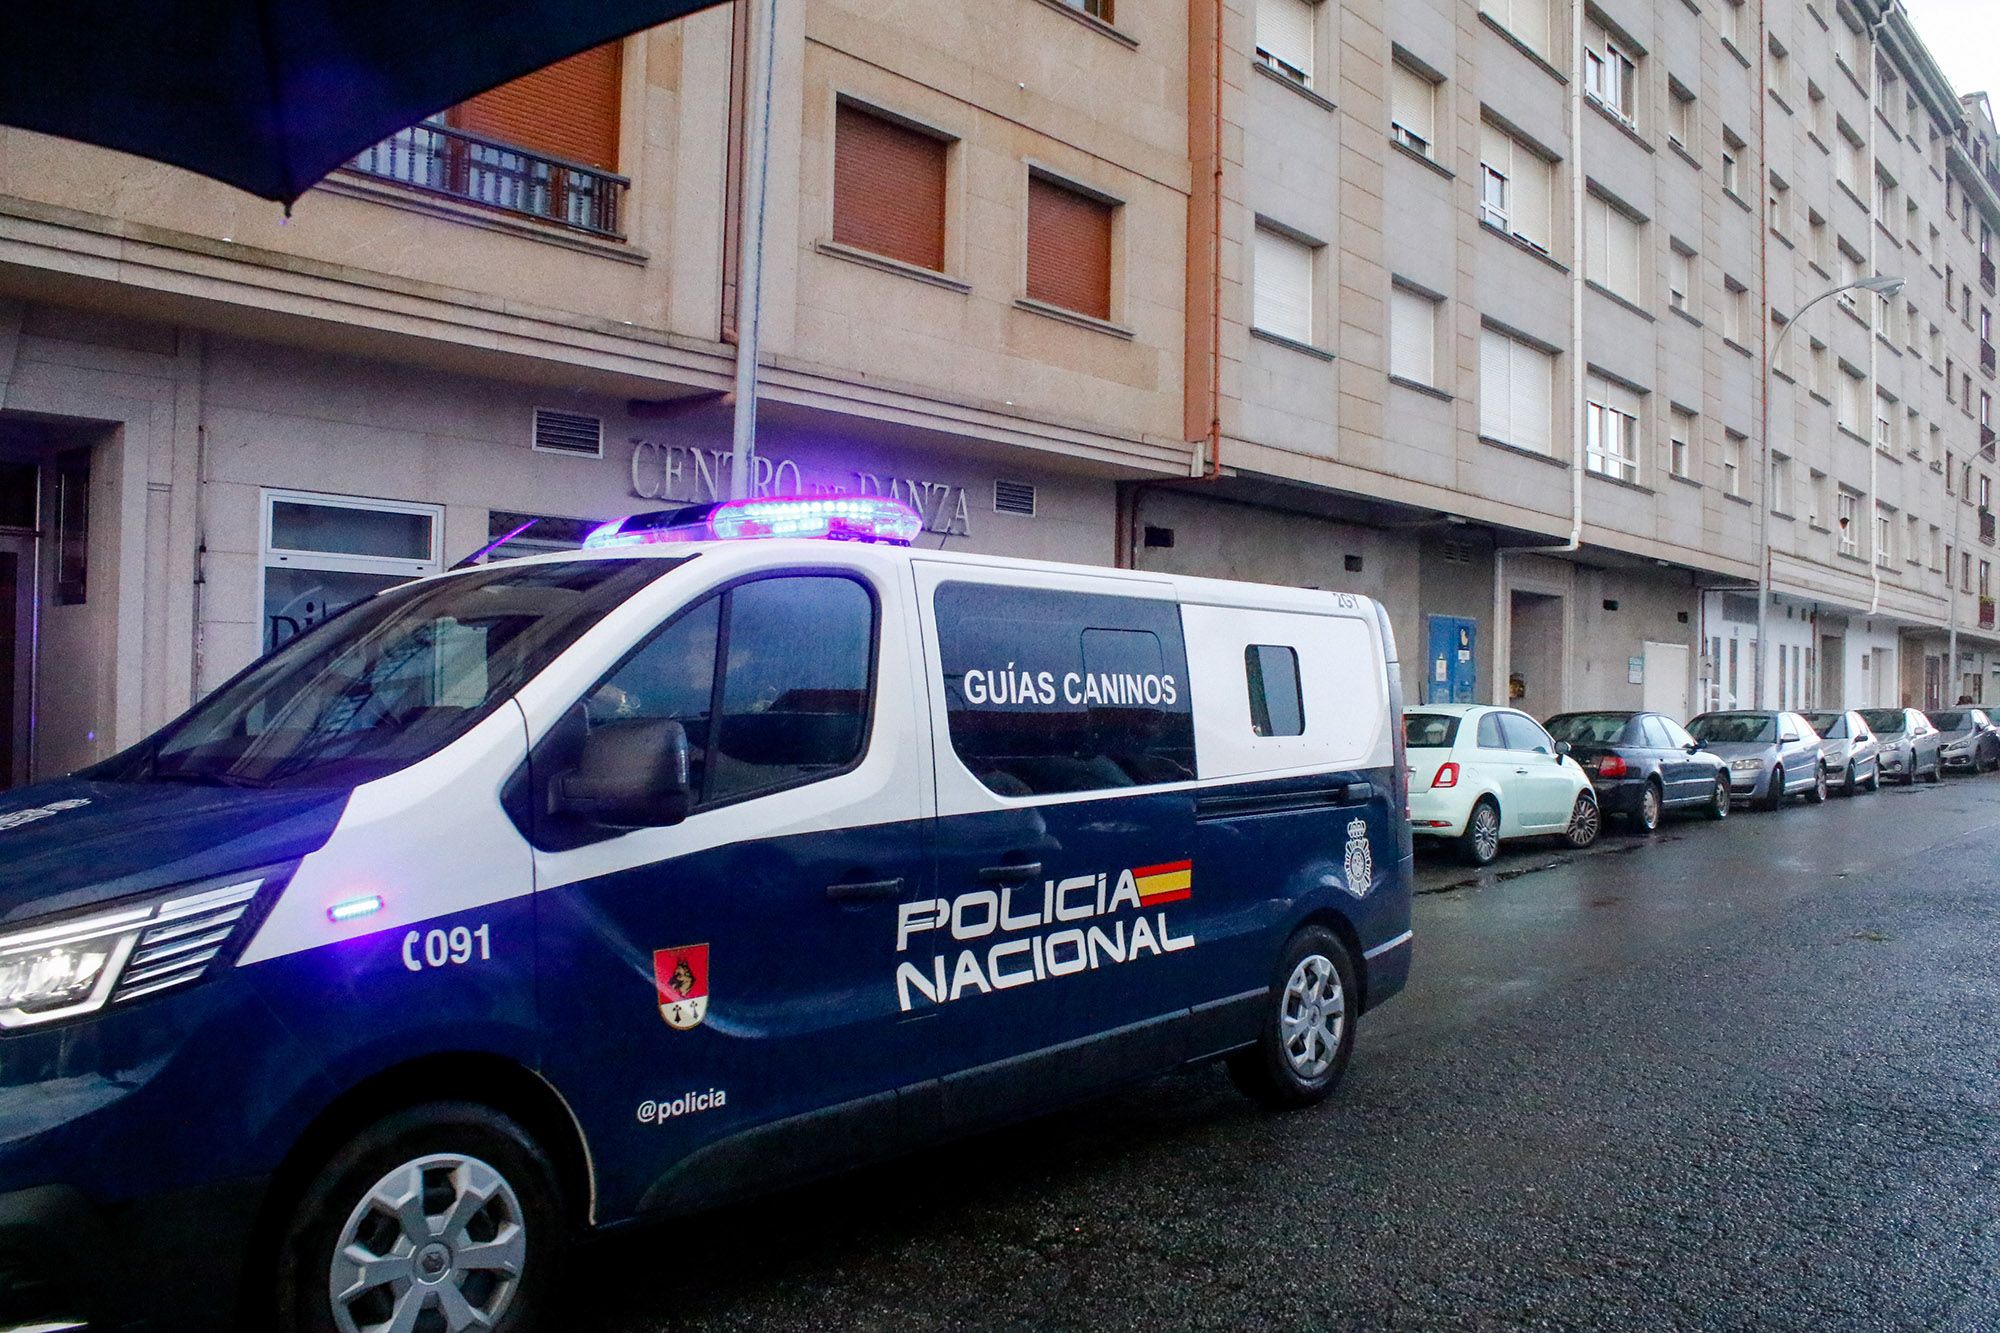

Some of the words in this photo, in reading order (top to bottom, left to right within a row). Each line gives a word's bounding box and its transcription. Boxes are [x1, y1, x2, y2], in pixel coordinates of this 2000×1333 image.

[632, 440, 802, 502] CENRO
[964, 662, 1056, 704] GUÍAS
[1063, 672, 1177, 705] CANINOS
[424, 923, 491, 968] 091
[896, 913, 1195, 1011] NACIONAL
[636, 1088, 726, 1124] @policia
